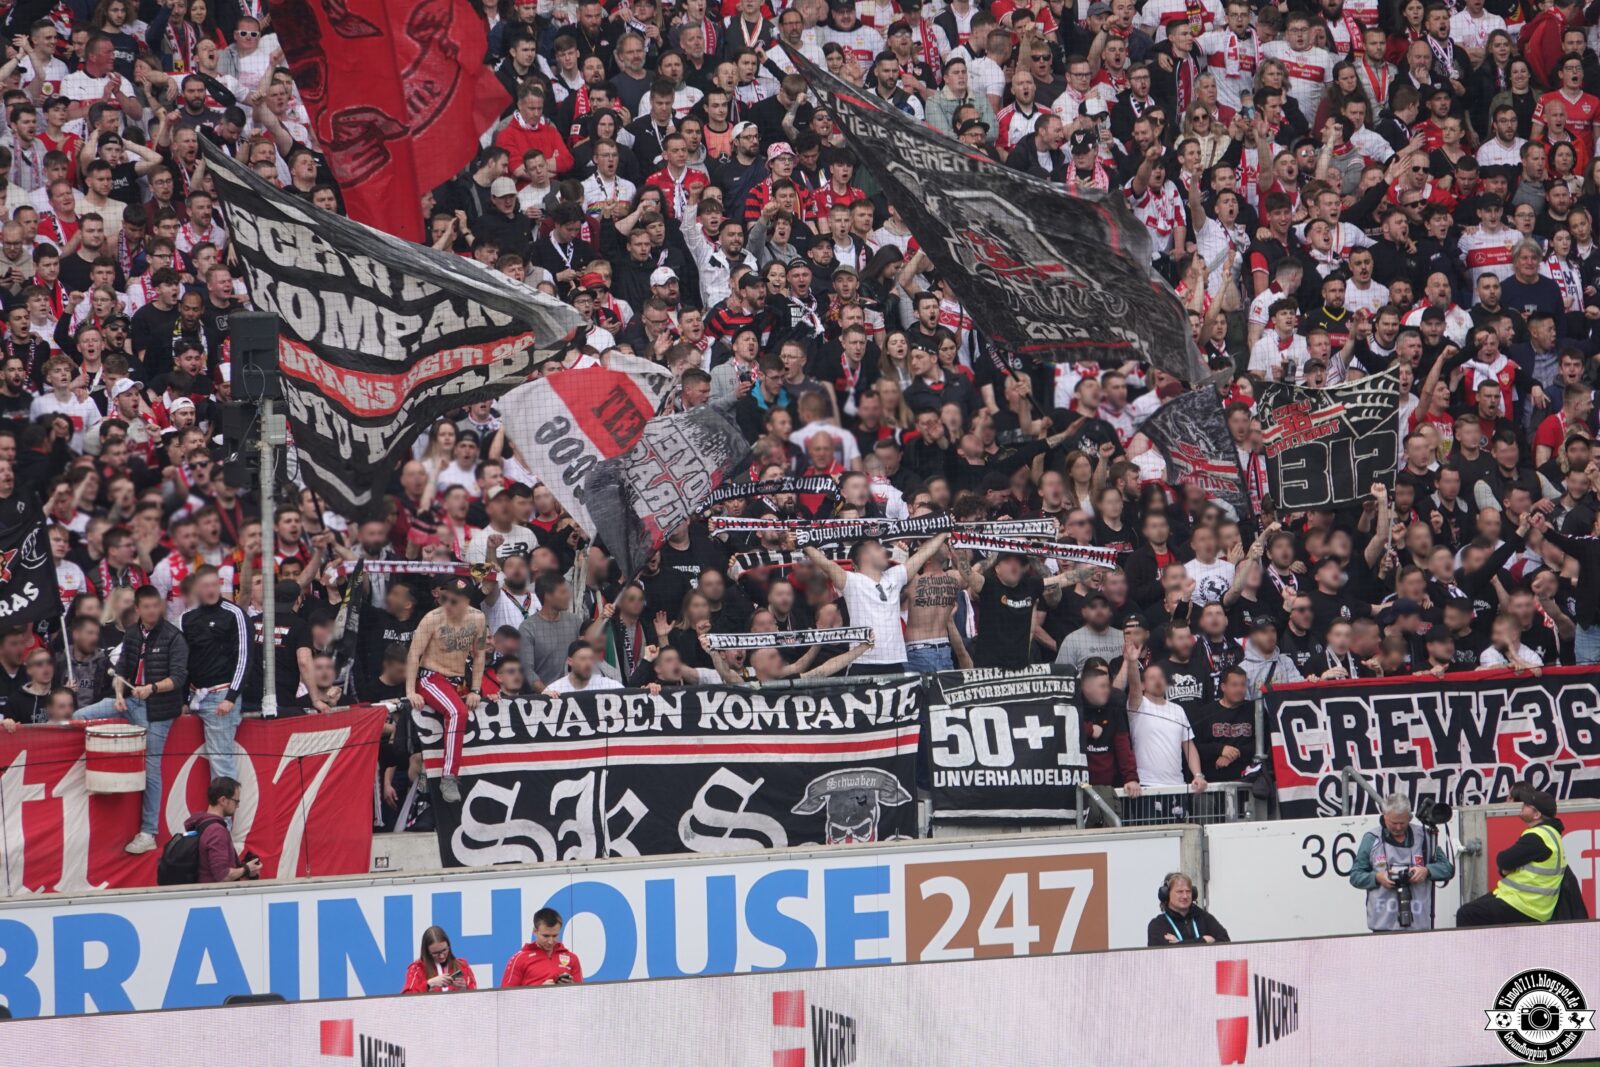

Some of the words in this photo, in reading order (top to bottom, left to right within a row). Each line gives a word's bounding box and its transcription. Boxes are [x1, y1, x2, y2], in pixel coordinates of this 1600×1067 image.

[241, 255, 513, 362] KOMPAN
[795, 524, 863, 546] Schwaben
[696, 678, 922, 733] KOMPANIE
[1031, 680, 1076, 694] ULTRAS
[928, 703, 1089, 768] 50+1
[1276, 688, 1508, 777] CREW
[826, 774, 877, 791] Schwaben
[933, 768, 1090, 789] UNVERHANDELBAR
[1301, 833, 1357, 880] 36
[919, 867, 1095, 962] 247
[1375, 897, 1423, 915] FOO
[810, 1004, 857, 1067] WÜRTH
[1253, 973, 1299, 1048] WÜRTH
